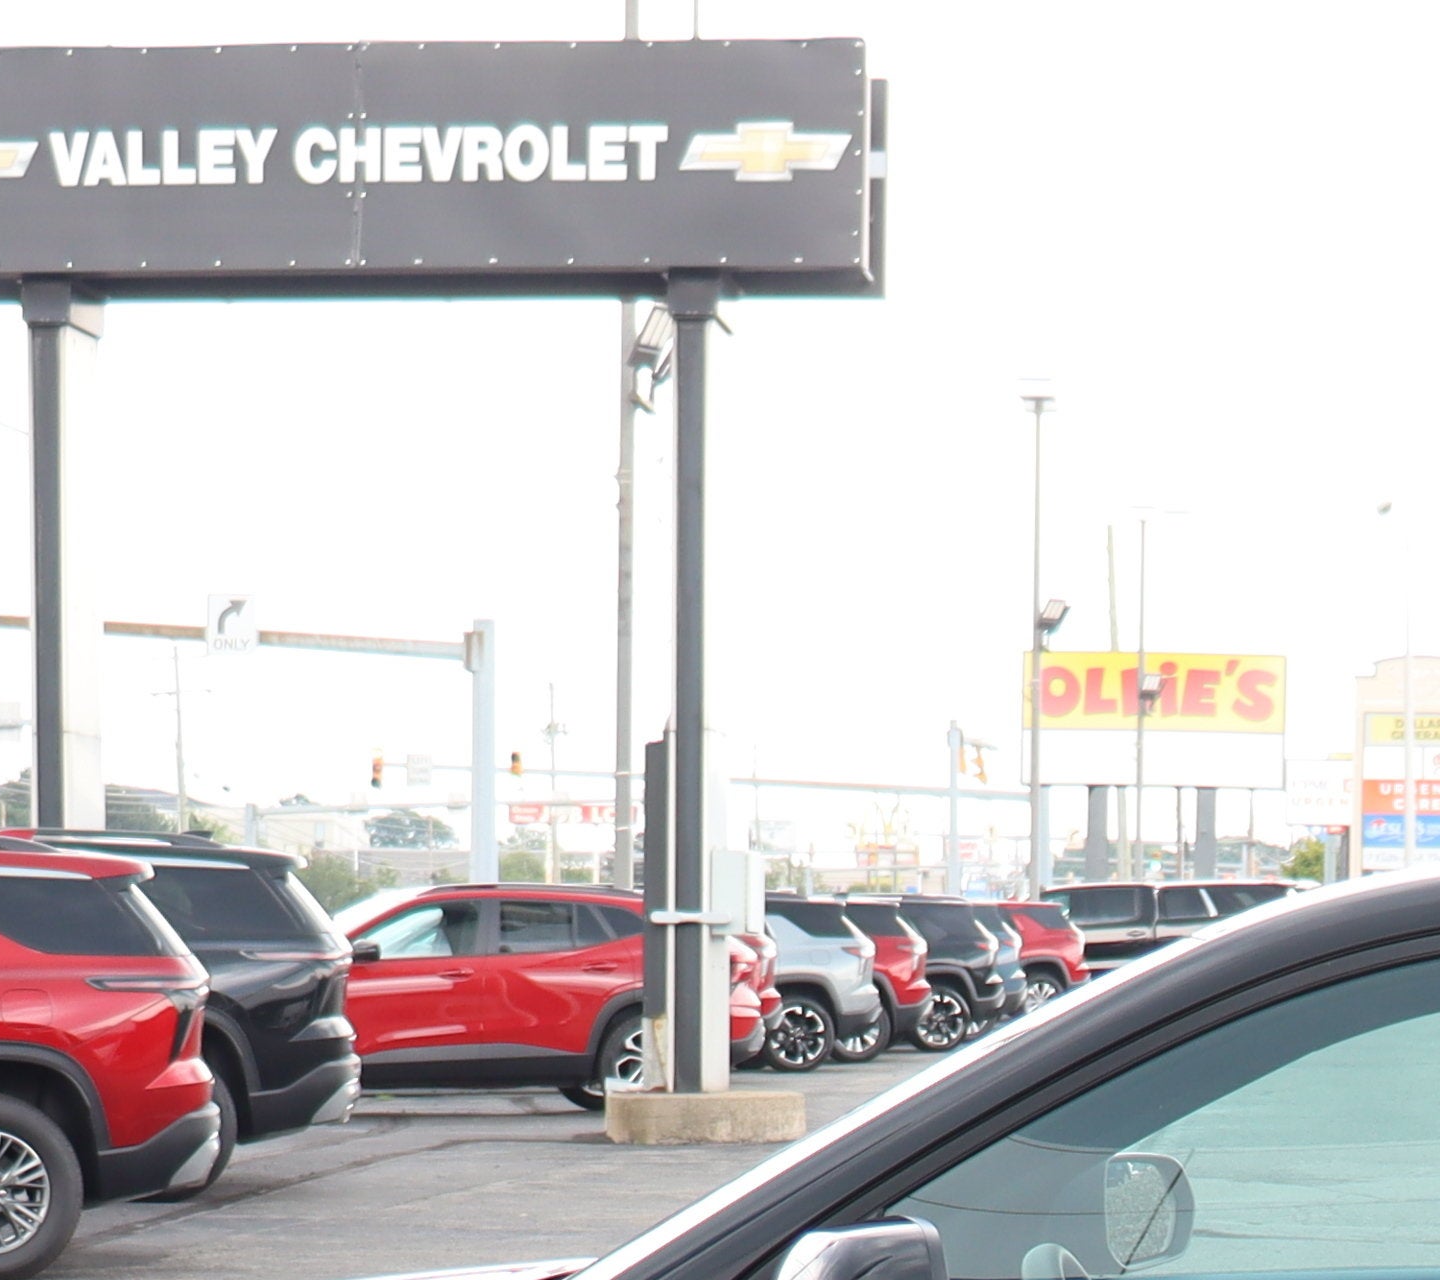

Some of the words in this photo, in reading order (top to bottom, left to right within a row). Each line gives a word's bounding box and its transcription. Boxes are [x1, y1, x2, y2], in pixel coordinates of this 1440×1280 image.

[50, 129, 277, 187] VALLEY
[293, 124, 668, 184] CHEVROLET
[213, 638, 251, 652] ONLY
